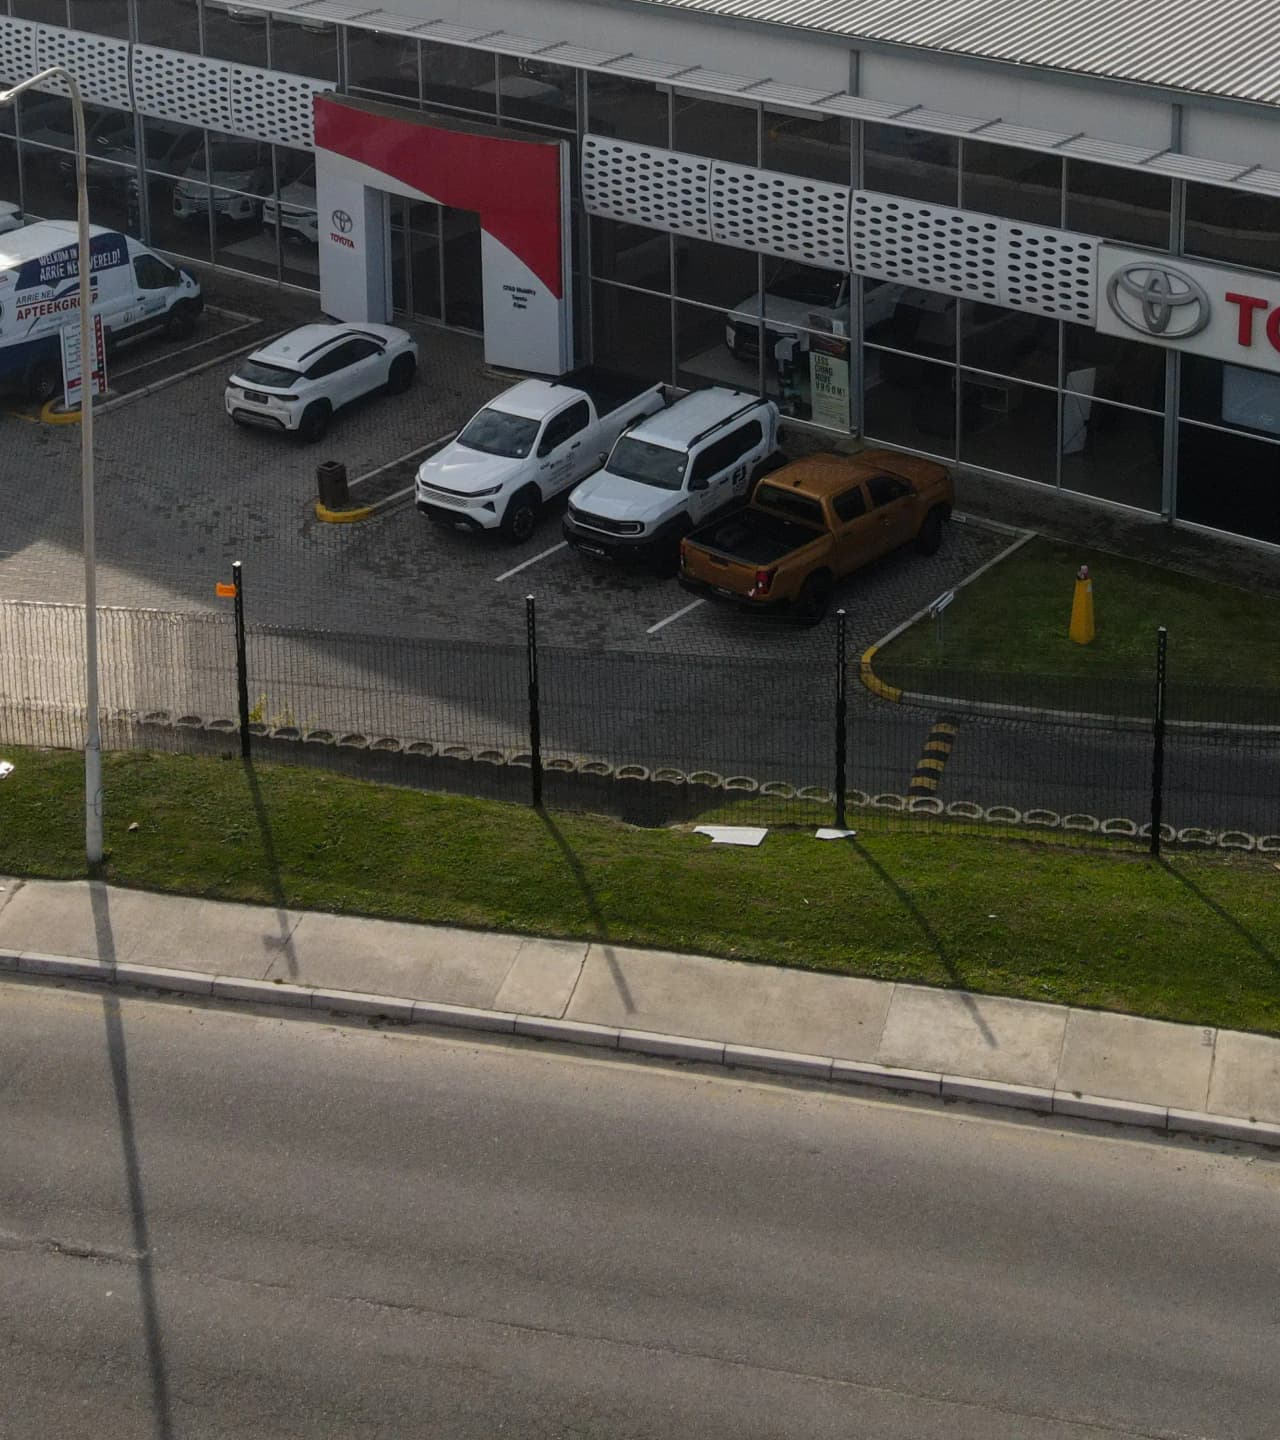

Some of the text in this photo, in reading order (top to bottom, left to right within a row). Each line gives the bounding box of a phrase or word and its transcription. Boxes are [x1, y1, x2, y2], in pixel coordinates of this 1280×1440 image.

[329, 232, 355, 249] TOYOTA
[39, 248, 78, 265] WELKOM IN
[39, 263, 66, 282] ARRIE
[16, 289, 56, 305] ARRIE NEL
[16, 292, 98, 321] APTEEKGRP
